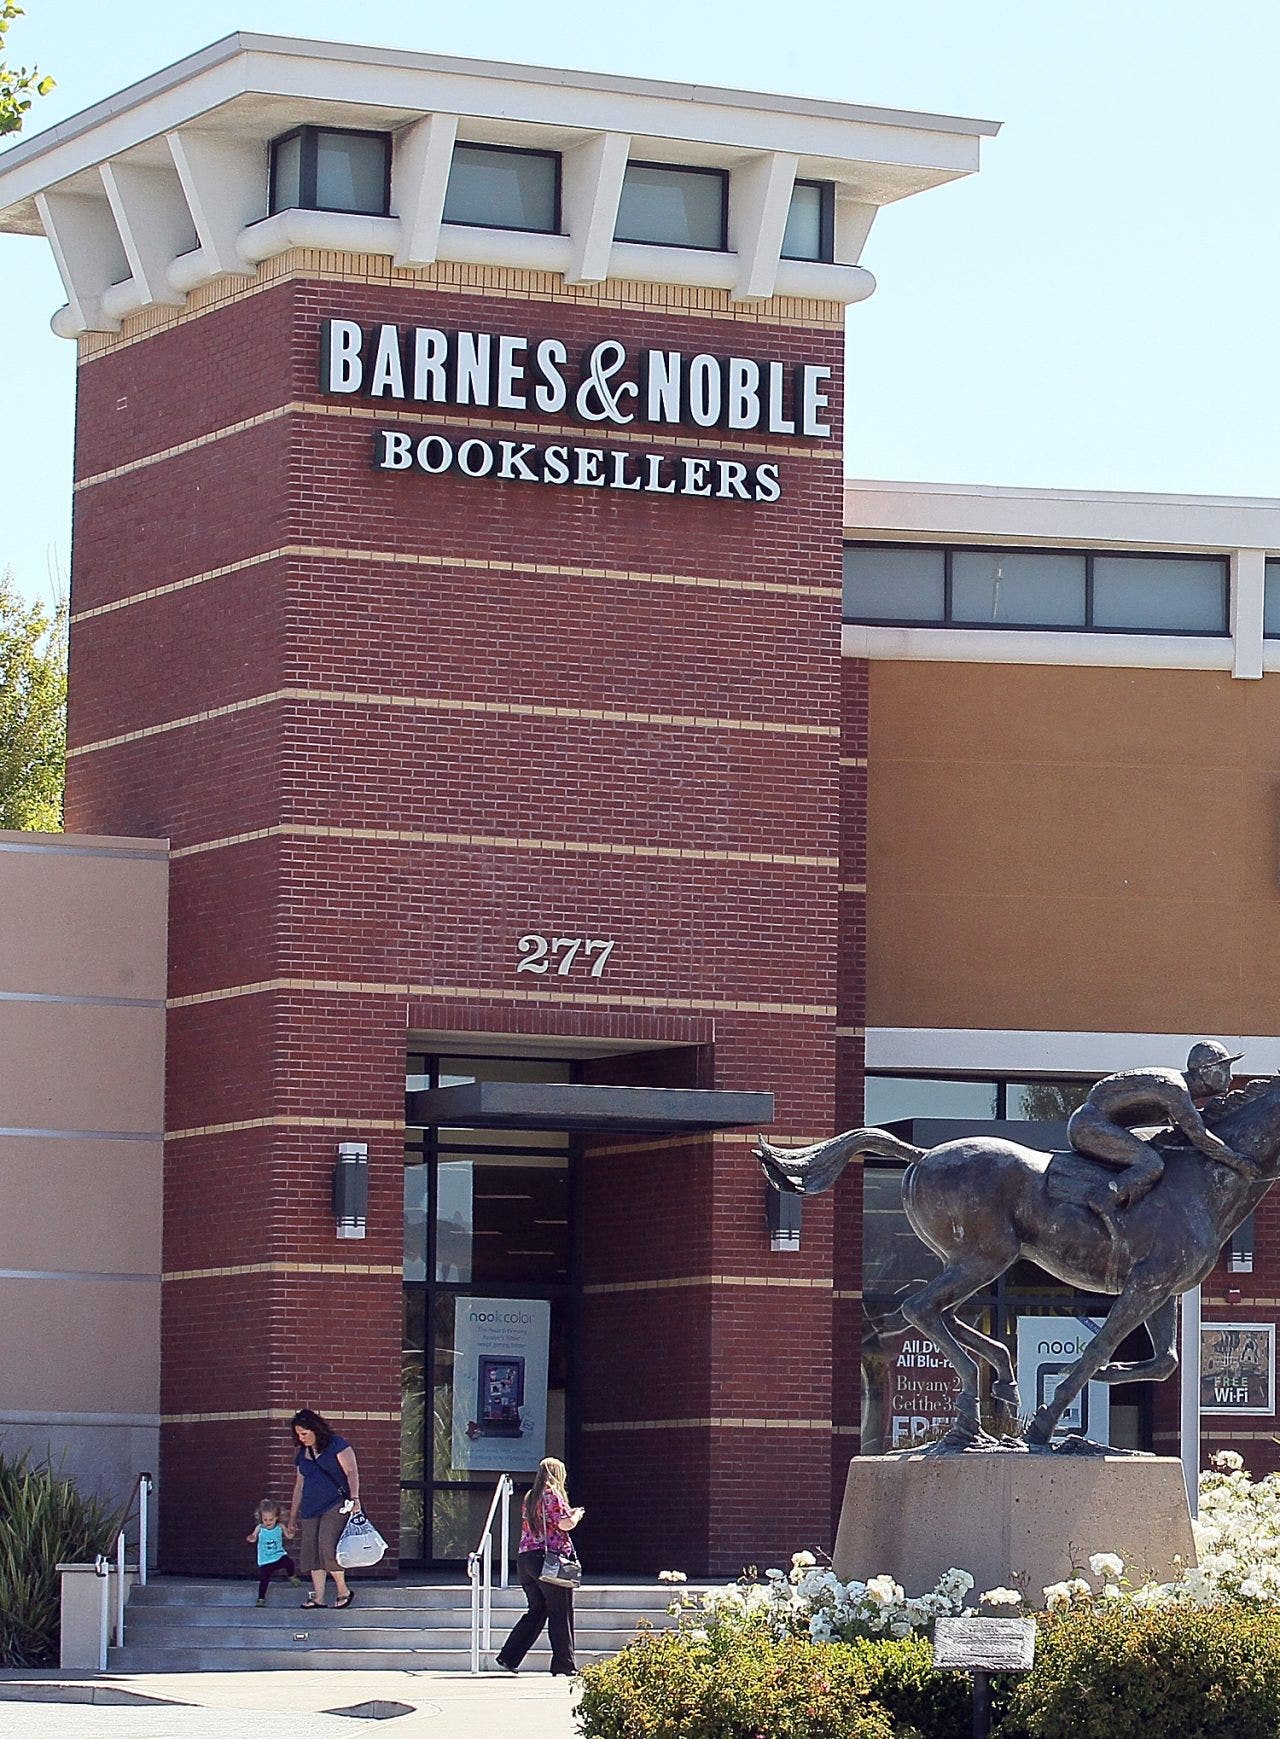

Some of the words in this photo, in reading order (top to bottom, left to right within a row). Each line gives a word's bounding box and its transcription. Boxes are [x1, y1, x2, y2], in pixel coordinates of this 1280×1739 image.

[328, 320, 567, 414] BARNES
[646, 349, 831, 437] NOBLE
[380, 430, 782, 502] BOOKSELLERS
[516, 934, 615, 977] 277
[902, 1340, 920, 1353] All
[1037, 1336, 1087, 1354] nook
[896, 1354, 914, 1368] All
[897, 1375, 924, 1396] Buy
[925, 1381, 951, 1396] any
[892, 1394, 917, 1411] Get
[918, 1395, 941, 1411] the
